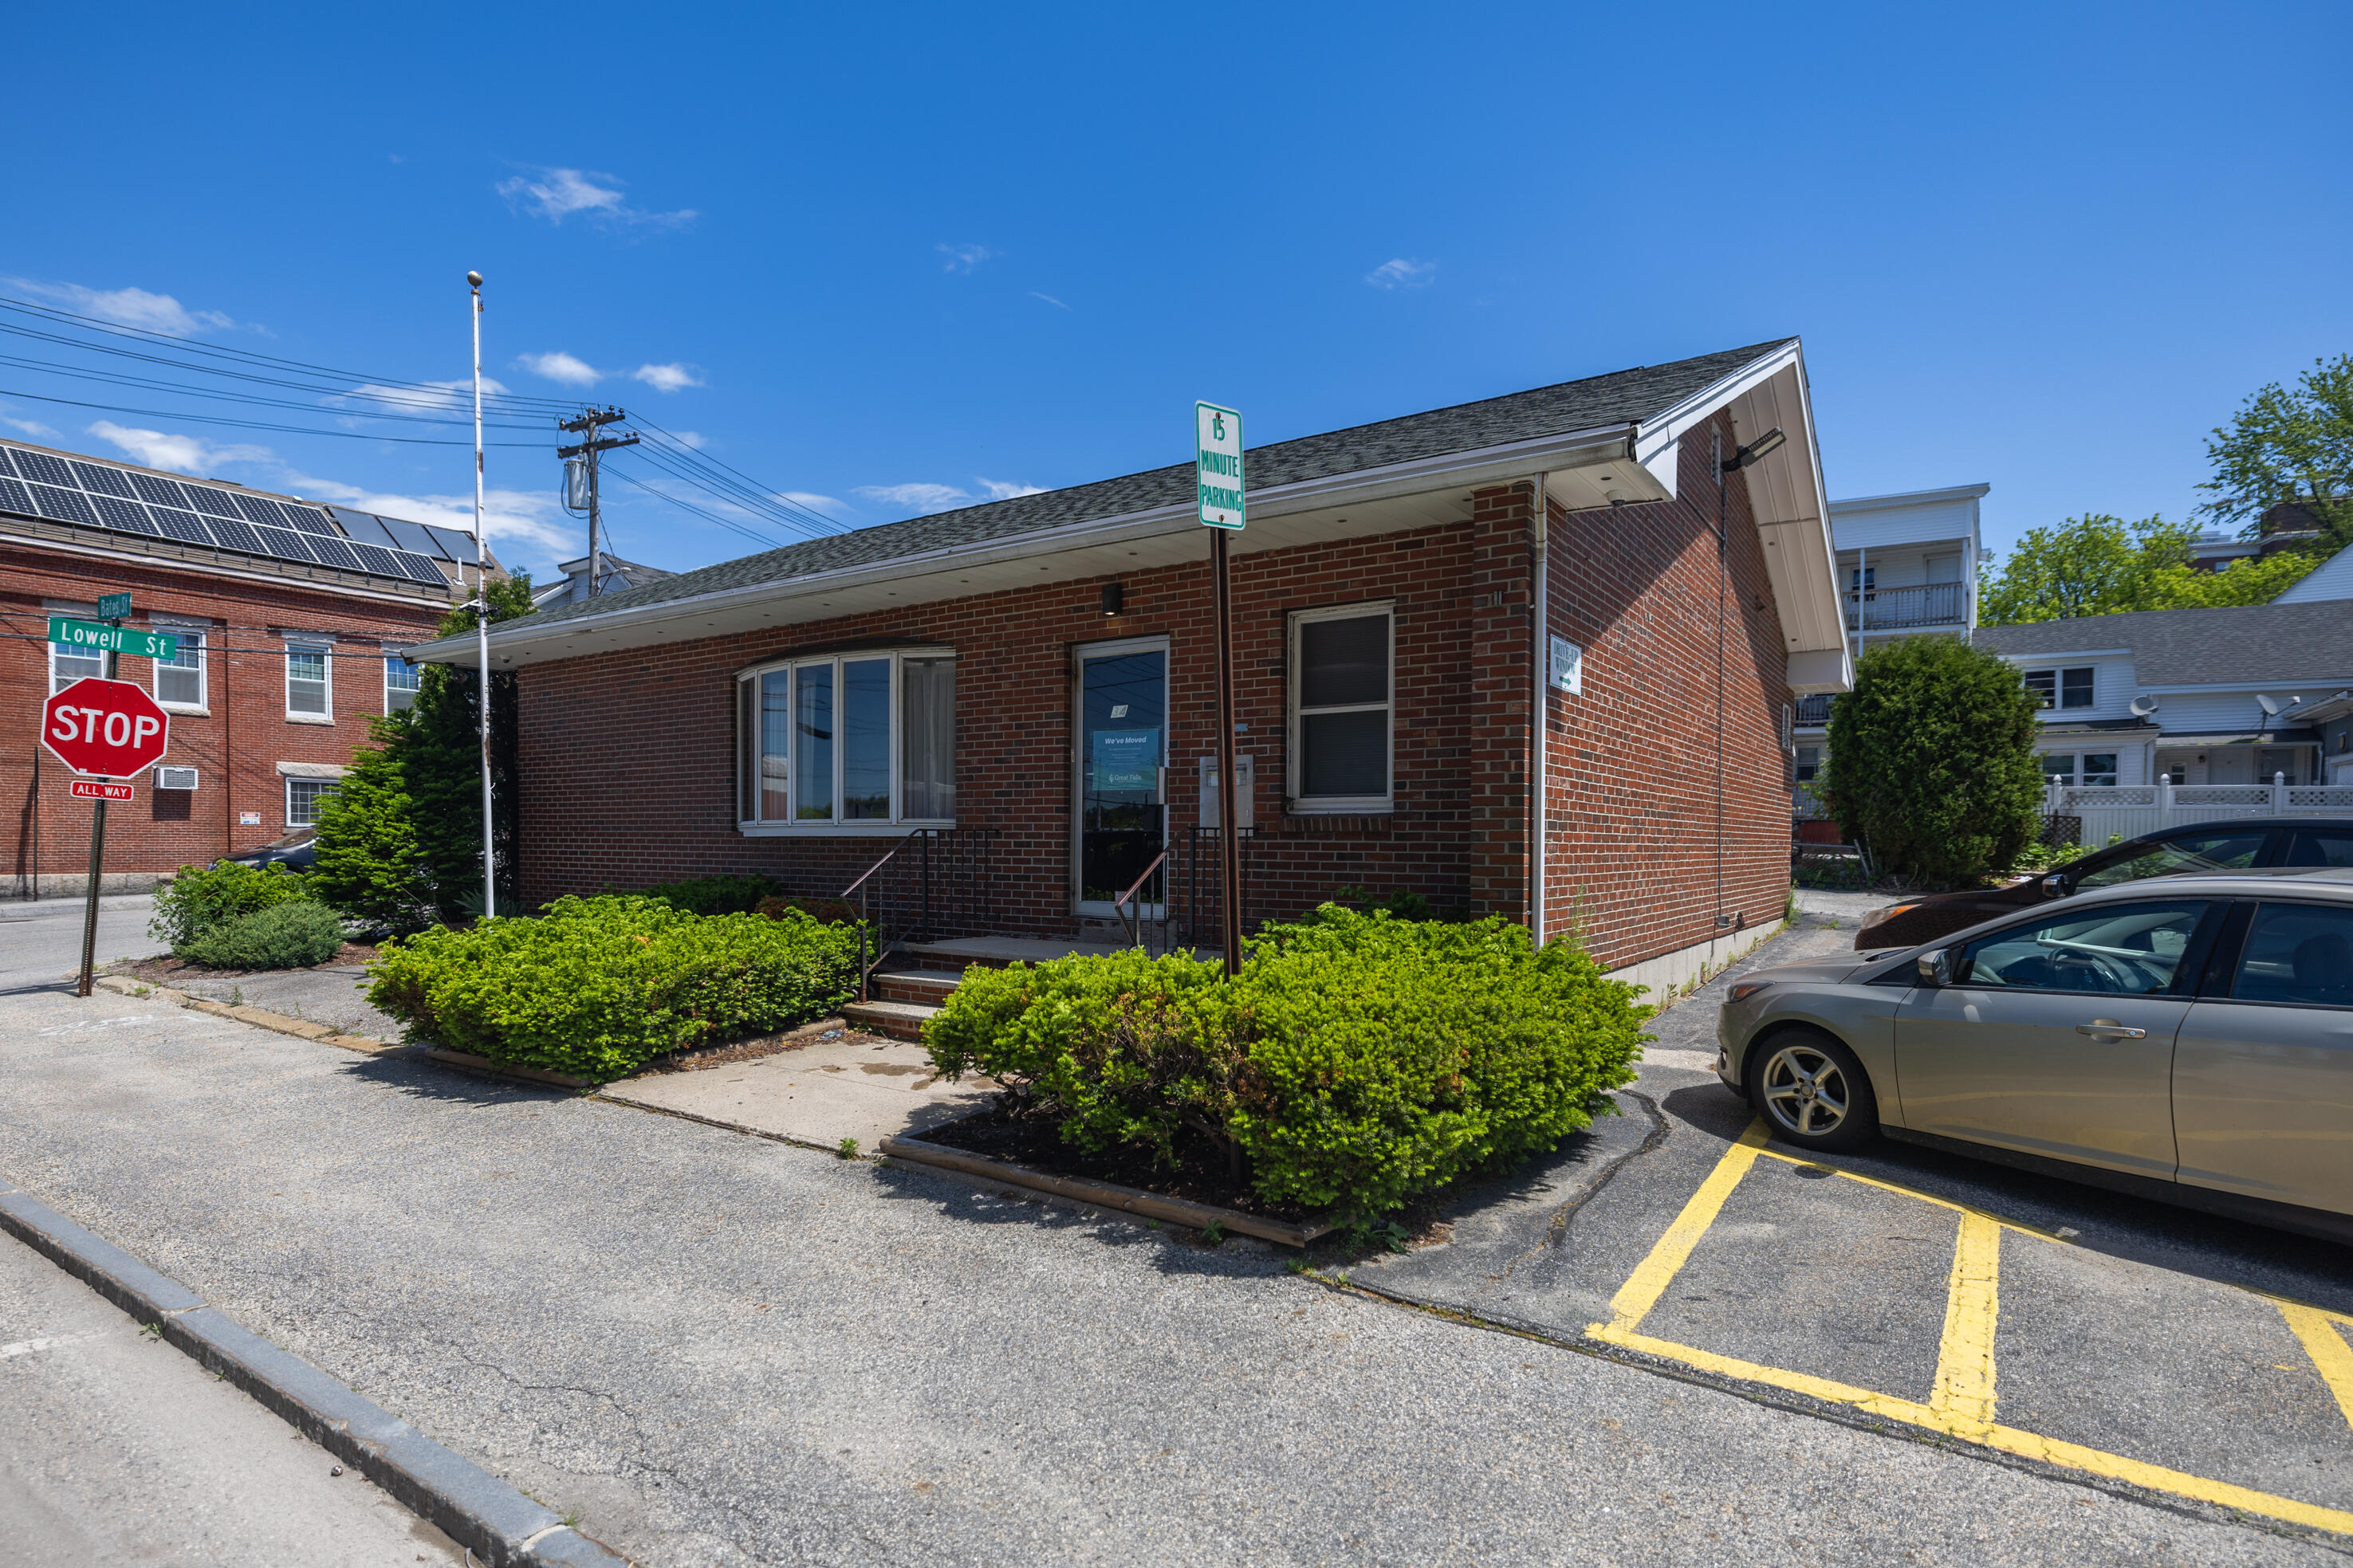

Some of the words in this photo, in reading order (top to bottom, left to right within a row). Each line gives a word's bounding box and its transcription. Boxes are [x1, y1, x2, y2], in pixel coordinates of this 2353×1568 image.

[1212, 418, 1226, 441] 15
[1201, 449, 1239, 477] MINUTE
[1201, 484, 1241, 512] PARKING
[100, 599, 119, 617] Bates
[120, 599, 128, 613] St
[61, 622, 123, 649] Lowell
[145, 636, 167, 656] St
[51, 705, 160, 749] STOP
[77, 784, 99, 796] ALL
[104, 787, 128, 797] WAY
